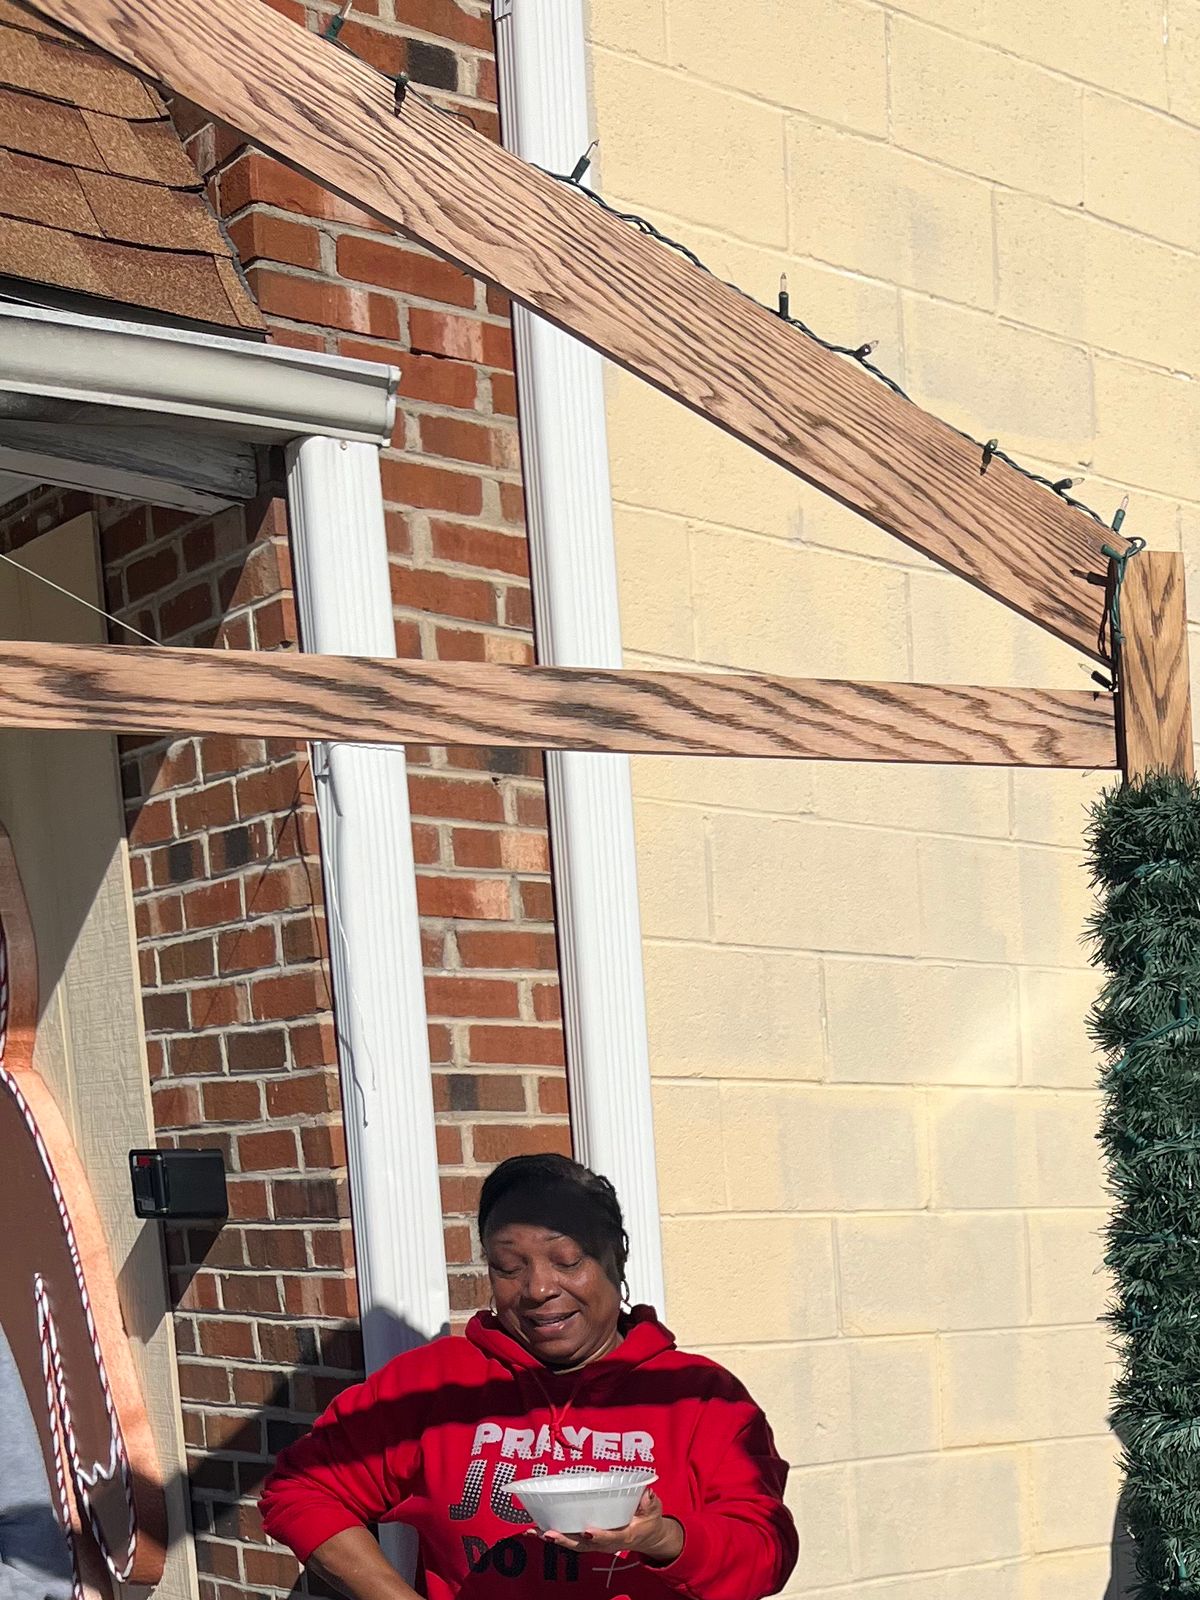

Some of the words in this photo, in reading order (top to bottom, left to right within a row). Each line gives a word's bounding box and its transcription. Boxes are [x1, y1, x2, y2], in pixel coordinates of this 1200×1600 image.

[471, 1423, 655, 1462] PRAYER
[448, 1458, 656, 1524] JU
[461, 1535, 527, 1578] DO
